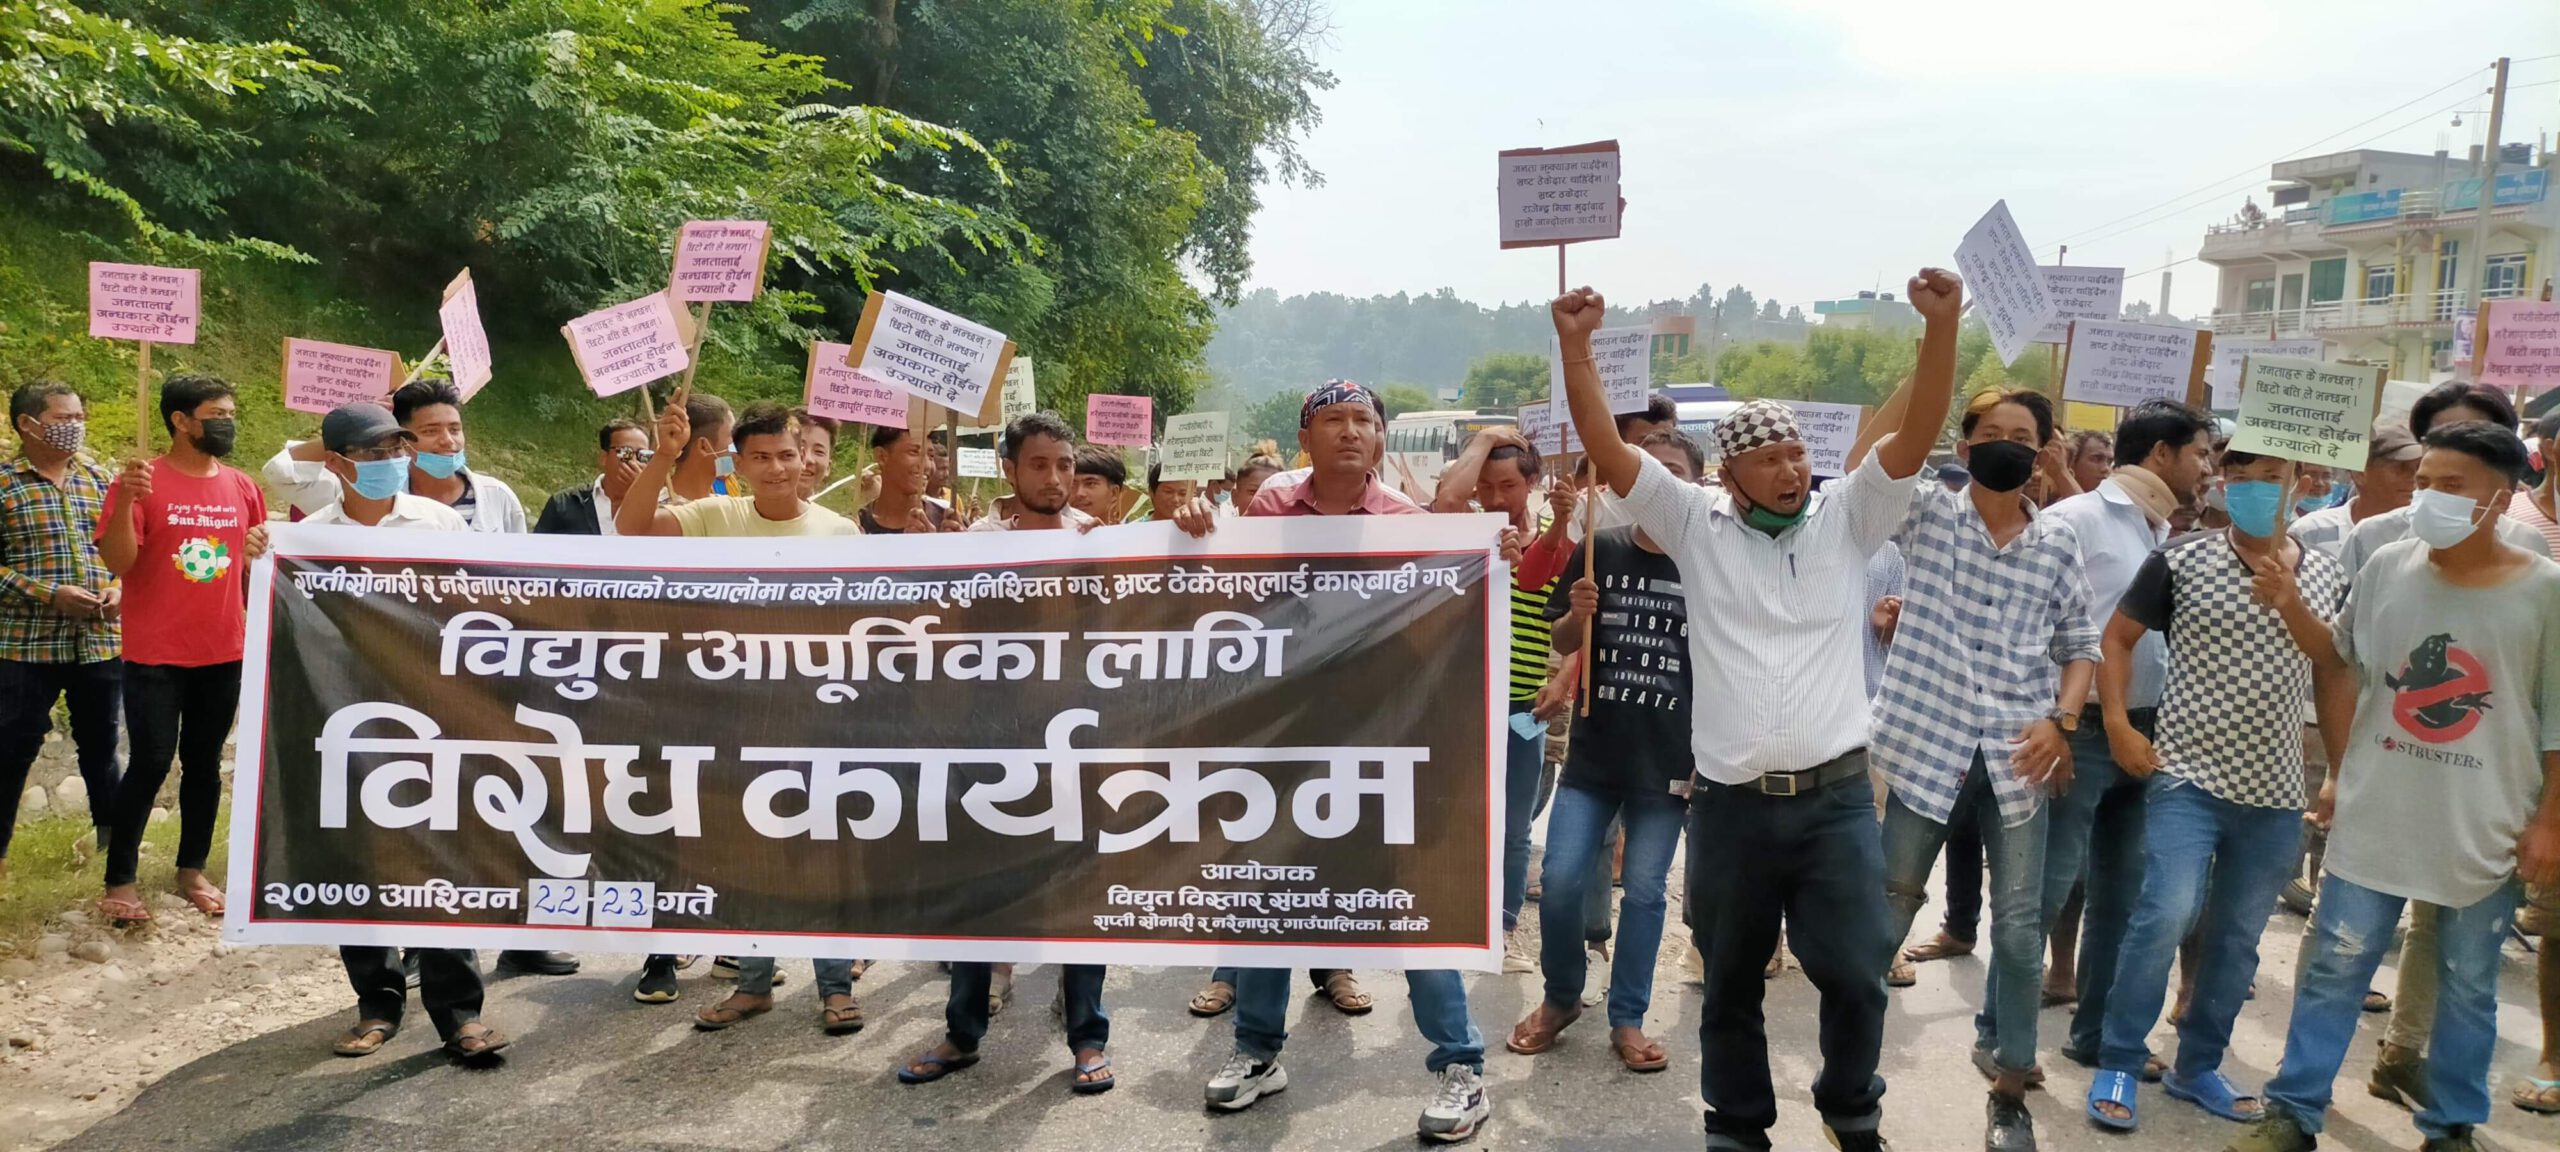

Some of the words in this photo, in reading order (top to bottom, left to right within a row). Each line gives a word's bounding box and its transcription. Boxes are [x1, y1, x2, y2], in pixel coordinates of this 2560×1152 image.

[692, 255, 742, 267] जनतालाई
[679, 270, 723, 281] अन्धकार
[725, 269, 752, 281] होईन
[687, 282, 726, 294] उज्यालो
[728, 282, 738, 295] दे
[112, 298, 174, 311] जनतालाई
[96, 309, 152, 322] अन्धकार
[156, 312, 191, 325] होईन
[893, 302, 939, 327] जनताहरु
[940, 320, 952, 331] के
[112, 322, 160, 335] उज्यालो
[164, 325, 175, 336] दे
[889, 317, 914, 334] छिटो
[933, 334, 945, 347] ले
[601, 331, 657, 360] जनतालाई
[896, 339, 971, 374] जनतालाई
[592, 352, 643, 378] अन्धकार
[646, 341, 676, 359] होईन
[872, 345, 940, 378] अन्धकार
[942, 370, 982, 394] होईन
[611, 362, 656, 385] उज्यालो
[658, 358, 668, 369] दे
[2257, 365, 2304, 380] जनताहरु
[2306, 368, 2317, 380] के
[829, 382, 850, 395] छिटो
[851, 387, 873, 398] भन्दा
[873, 389, 893, 401] छिटो
[885, 366, 945, 396] उज्यालो
[946, 387, 960, 403] दे
[2256, 380, 2281, 395] छिटो
[2303, 386, 2313, 400] ले
[813, 395, 836, 410] विद्युत
[837, 401, 863, 414] आपूर्ति
[891, 408, 906, 418] गर
[2267, 402, 2344, 423] जनतालाई
[1679, 421, 1714, 432] हाकाली
[2245, 416, 2316, 437] अन्धकार
[2318, 425, 2363, 444] होईन
[2262, 435, 2325, 455] उज्यालो
[2327, 444, 2342, 460] दे
[167, 514, 195, 526] San
[196, 514, 238, 529] Miguel
[293, 566, 419, 603] राप्तीसोनारी
[422, 574, 443, 603] र
[440, 568, 559, 606] नरैनापुरका
[560, 575, 662, 601] जनताको
[666, 576, 788, 605] उज्यालोमा
[789, 576, 844, 606] बस्ने
[847, 576, 951, 609] अधिकार
[950, 570, 1064, 609] सुनिश्चित
[1113, 572, 1164, 600] भ्रष्ट
[1167, 563, 1313, 602] ठेकेदारलाई
[1313, 561, 1419, 600] कारबाही
[1422, 565, 1466, 596] गर
[1606, 575, 1645, 591] OSA
[1621, 596, 1673, 611] ORIGINALS
[1634, 614, 1688, 637] 1976
[439, 611, 669, 701] विद्युत
[682, 614, 1069, 704] आपूर्तिका
[1084, 610, 1293, 690] लागि
[1614, 671, 1657, 685] ADVANCE
[1598, 685, 1678, 710] CREATE
[314, 701, 714, 878] विरोध
[740, 708, 1430, 854] कार्यक्रम
[1200, 860, 1318, 881] आयोजक
[263, 882, 371, 912] २०७७
[378, 879, 520, 914] आश्विन
[657, 883, 718, 916] गते
[1107, 885, 1174, 911] विद्युत
[1178, 886, 1269, 914] विस्तार
[1268, 888, 1330, 912] संघर्ष
[1334, 888, 1415, 912] समिति
[1093, 912, 1135, 931] राप्ती
[1138, 912, 1194, 932] सोनारी
[1198, 916, 1213, 933] र
[1212, 913, 1285, 934] नरैनापुर
[1389, 915, 1431, 932] बाँके
